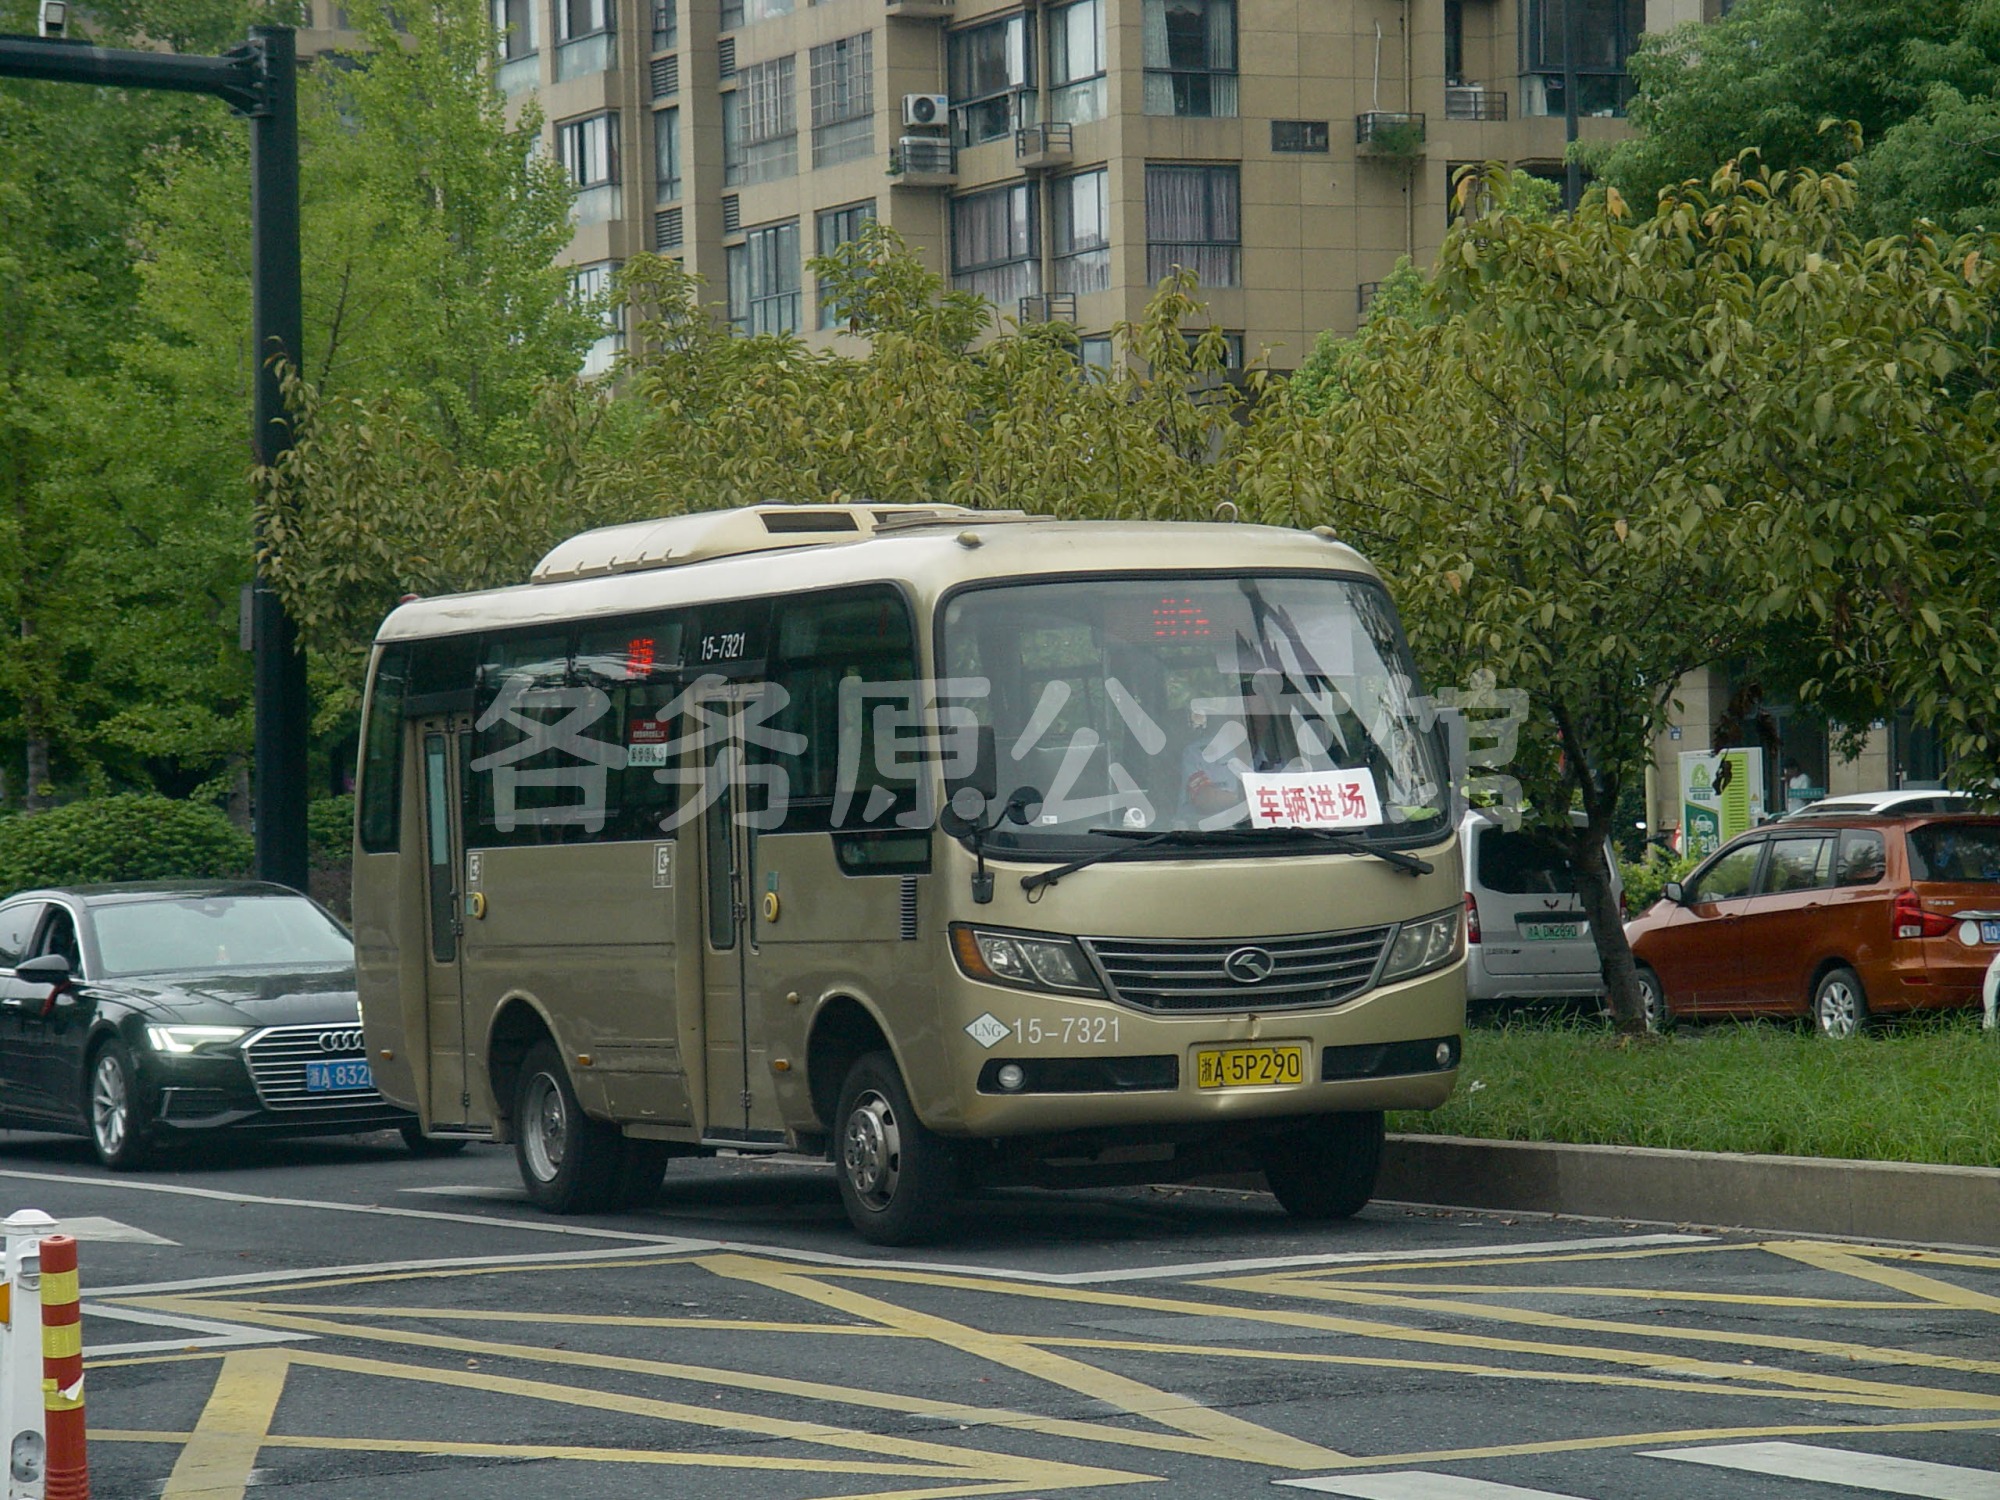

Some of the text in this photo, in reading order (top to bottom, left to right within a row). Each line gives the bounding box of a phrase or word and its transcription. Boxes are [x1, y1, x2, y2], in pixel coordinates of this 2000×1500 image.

[701, 632, 746, 660] 15-7321
[1256, 782, 1367, 823] 车辆进场
[974, 1022, 1002, 1037] LNG
[1013, 1016, 1120, 1044] 15-7321
[1201, 1053, 1300, 1082] 浙A·5P290
